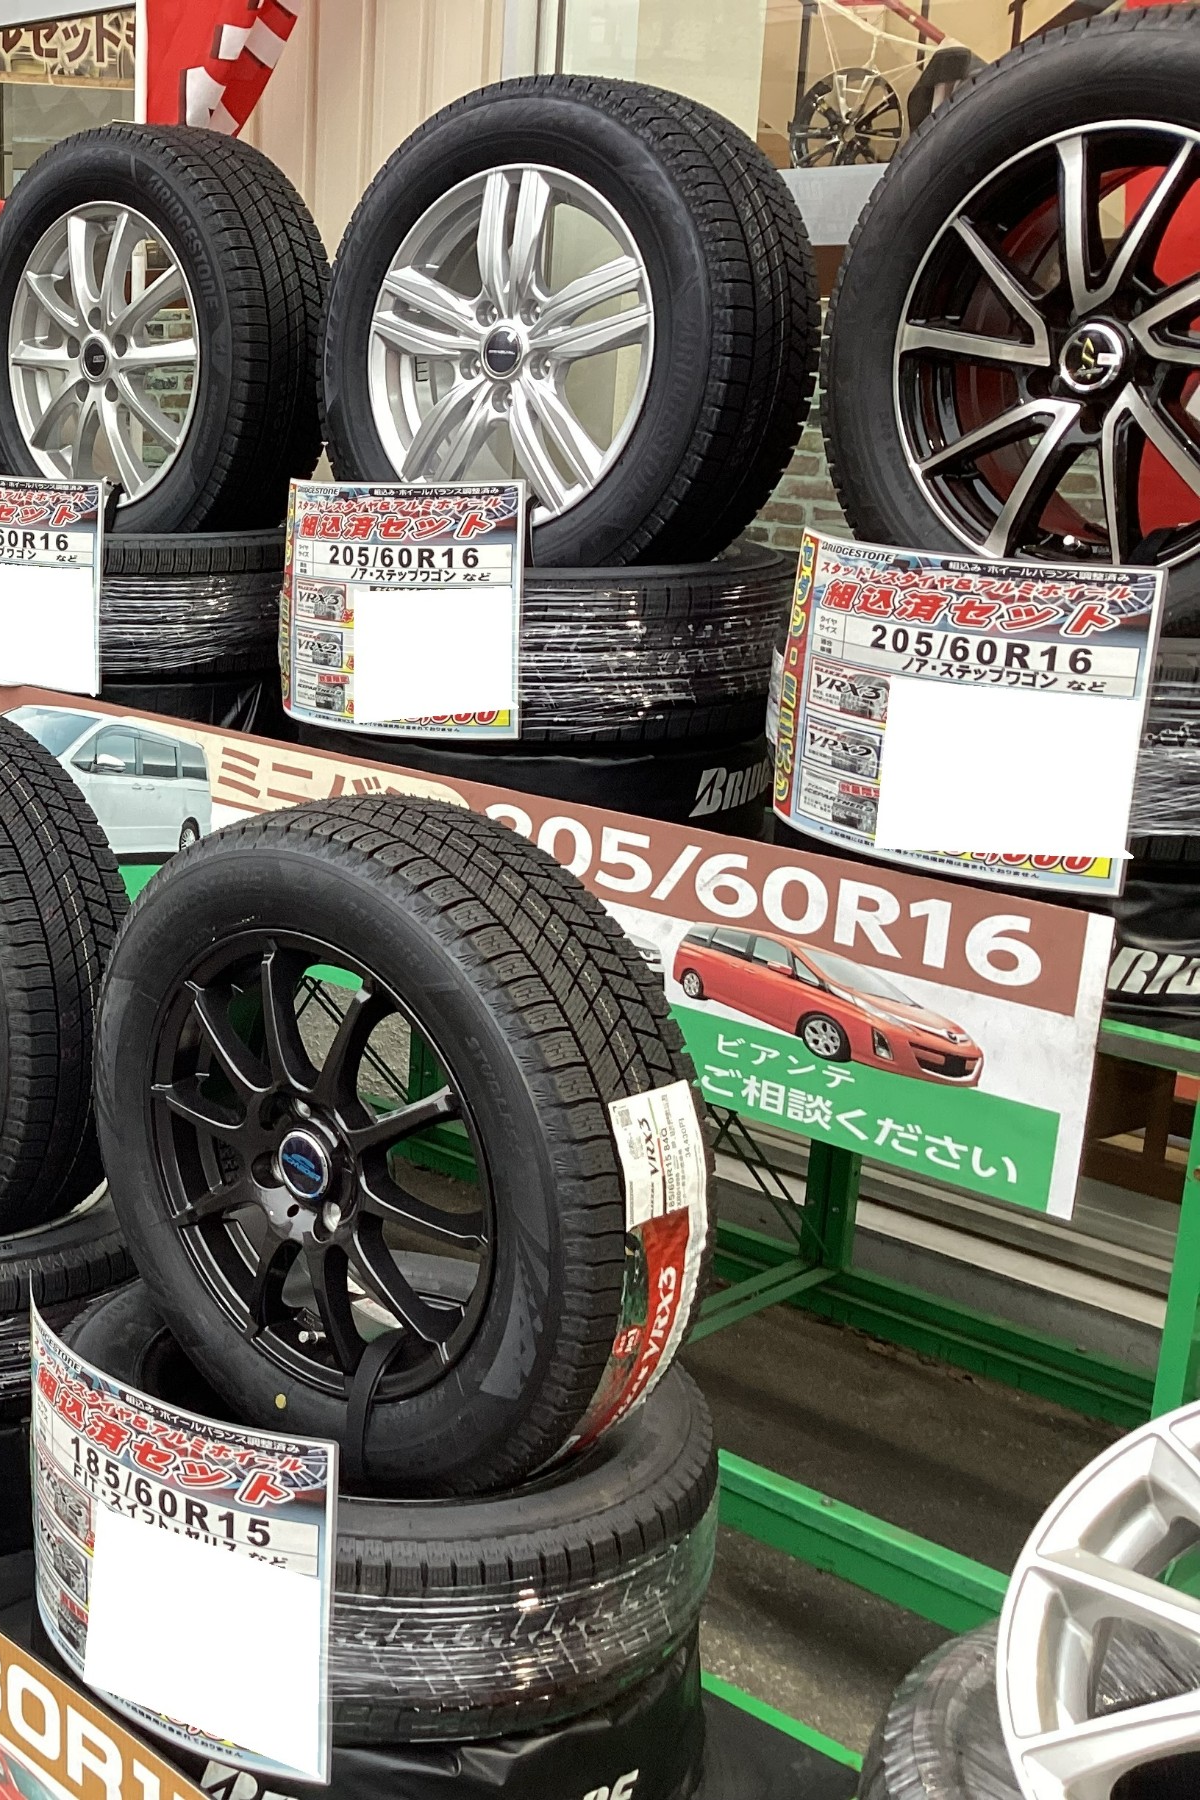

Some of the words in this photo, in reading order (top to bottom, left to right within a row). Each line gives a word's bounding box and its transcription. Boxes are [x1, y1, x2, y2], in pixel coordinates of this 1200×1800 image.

[299, 513, 497, 540] 組込済セット
[55, 554, 78, 564] など
[329, 544, 480, 569] 205/60R16
[350, 568, 457, 582] ノア・ステップワゴン
[462, 572, 492, 582] など
[821, 541, 895, 563] BRIDGESTONE
[949, 560, 1130, 583] 組込み・ホイールバランス調整済み
[820, 561, 1132, 601] スタッドレスタイヤ&アルミホイール
[822, 580, 1118, 636] 組込済セット
[870, 623, 1093, 675] 205/60R16
[814, 673, 883, 701] VRX3
[901, 656, 1058, 688] ノア・ステップワゴン
[1067, 678, 1107, 693] など
[807, 731, 873, 757] VRX2
[484, 802, 1042, 987] 205/60R16
[717, 1032, 856, 1090] ビアンテ
[637, 1116, 659, 1177] VRX3
[701, 1065, 1019, 1185] ご相談ください
[640, 1265, 677, 1362] VRX3
[36, 1366, 297, 1506] 組込済セット
[125, 1393, 301, 1454] 組込み・ホイールバランス調整済み
[70, 1435, 272, 1547] 185/60R15
